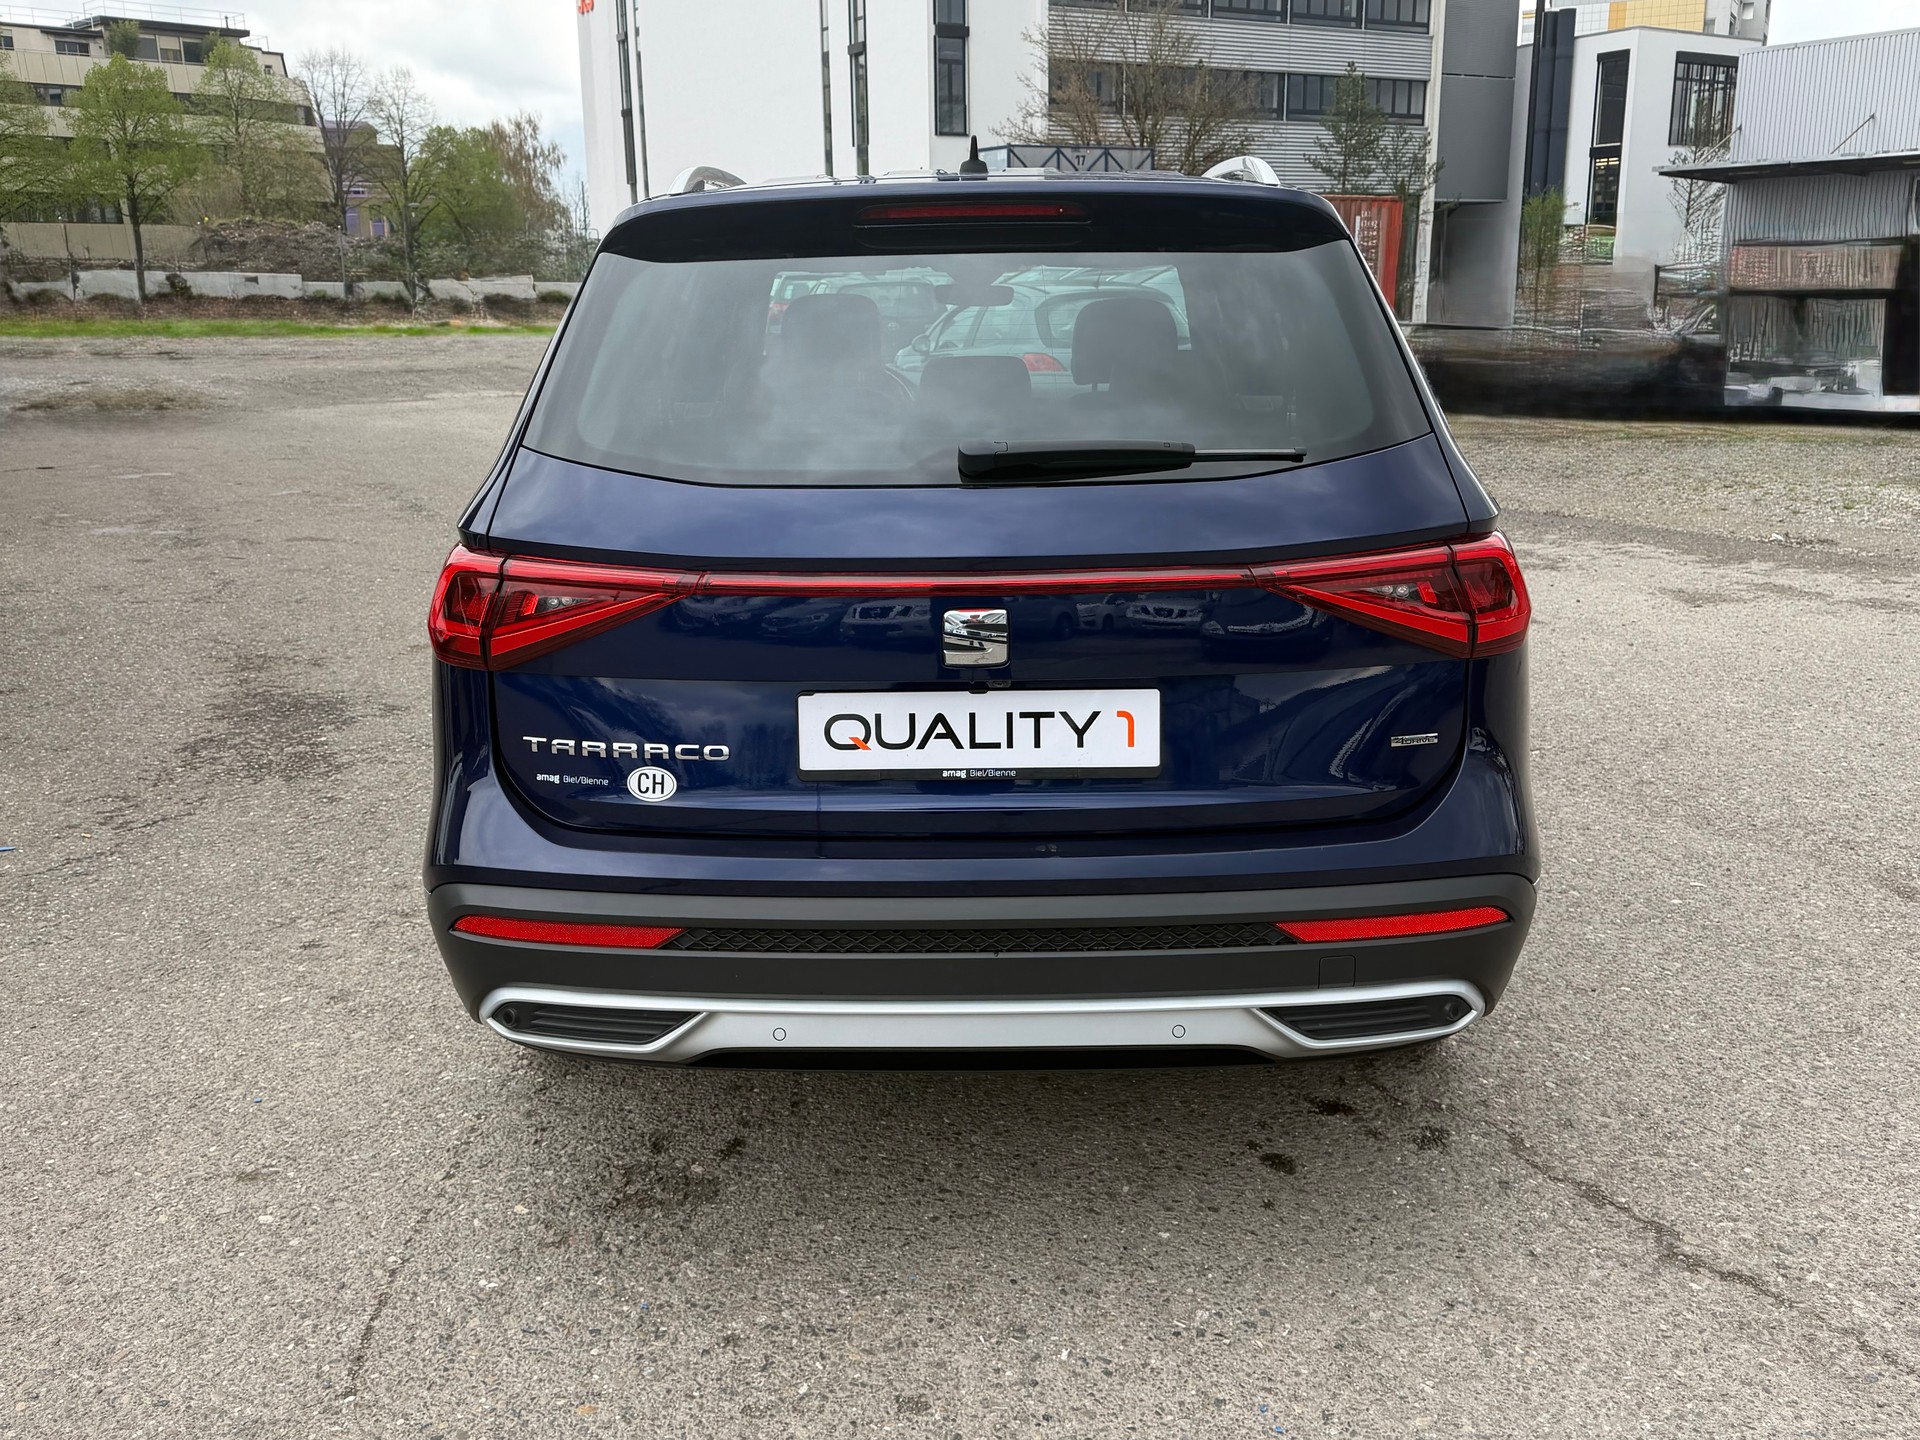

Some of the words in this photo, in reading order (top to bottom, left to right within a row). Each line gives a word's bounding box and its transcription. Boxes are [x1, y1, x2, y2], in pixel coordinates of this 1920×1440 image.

[1075, 154, 1086, 166] 17
[823, 710, 1102, 751] QUALITY
[1116, 710, 1135, 748] 1
[522, 736, 730, 761] TARRACO
[536, 773, 560, 785] amag
[563, 774, 609, 786] Biel/Bienne
[942, 769, 967, 779] amag
[970, 769, 1017, 778] Biel/Bienne
[637, 772, 665, 795] CH
